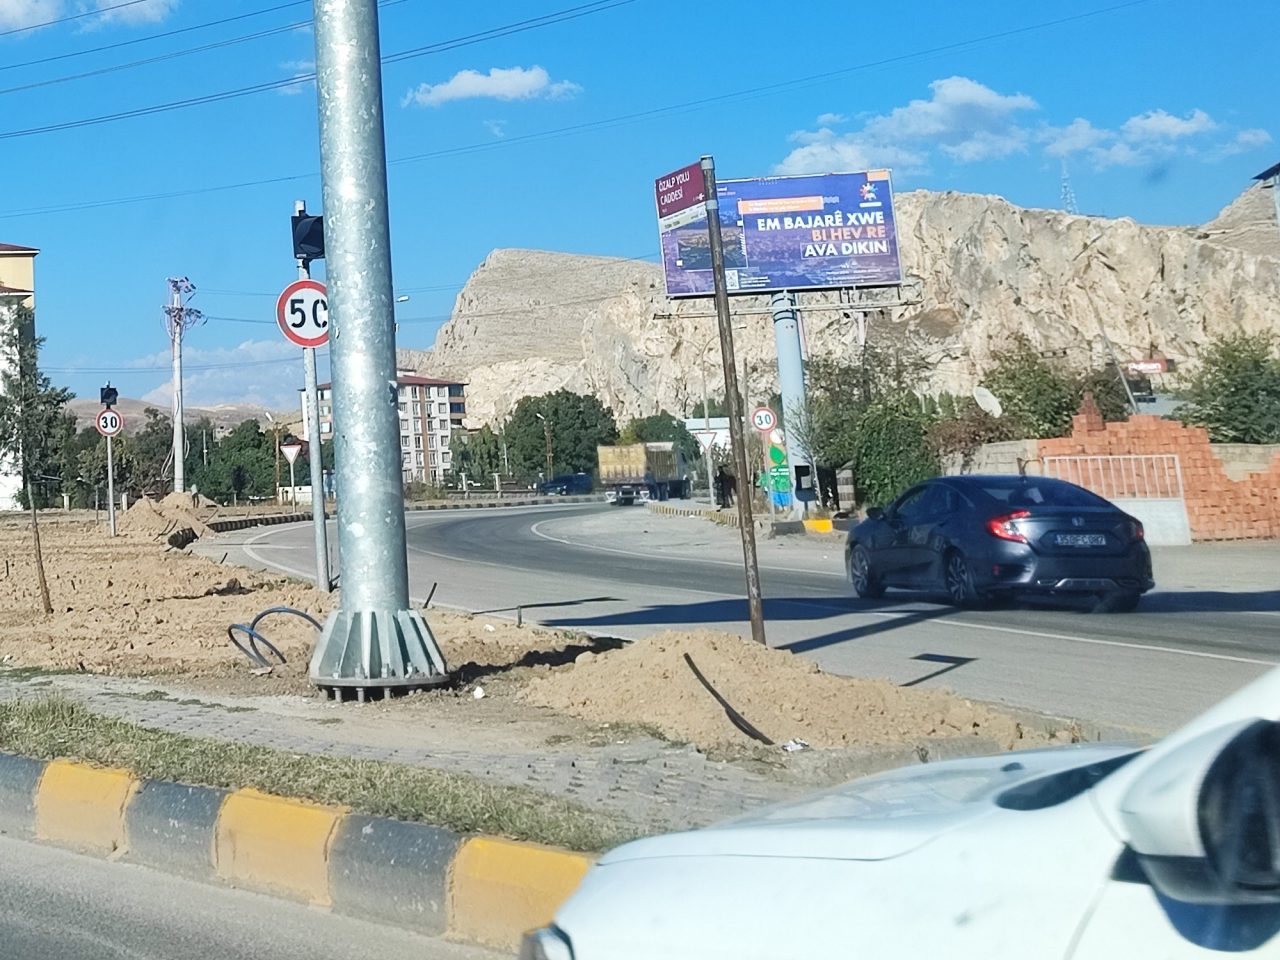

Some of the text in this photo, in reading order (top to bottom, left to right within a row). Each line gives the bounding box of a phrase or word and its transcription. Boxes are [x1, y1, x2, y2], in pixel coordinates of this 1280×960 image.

[658, 170, 690, 192] ÖZALP YOLU
[660, 186, 683, 206] CADDESİ
[757, 209, 884, 231] EM BAJARÊ XWE
[811, 225, 885, 242] BI HEV RE
[804, 240, 887, 257] AVA DIKIN
[101, 416, 118, 429] 30
[756, 413, 771, 426] 30
